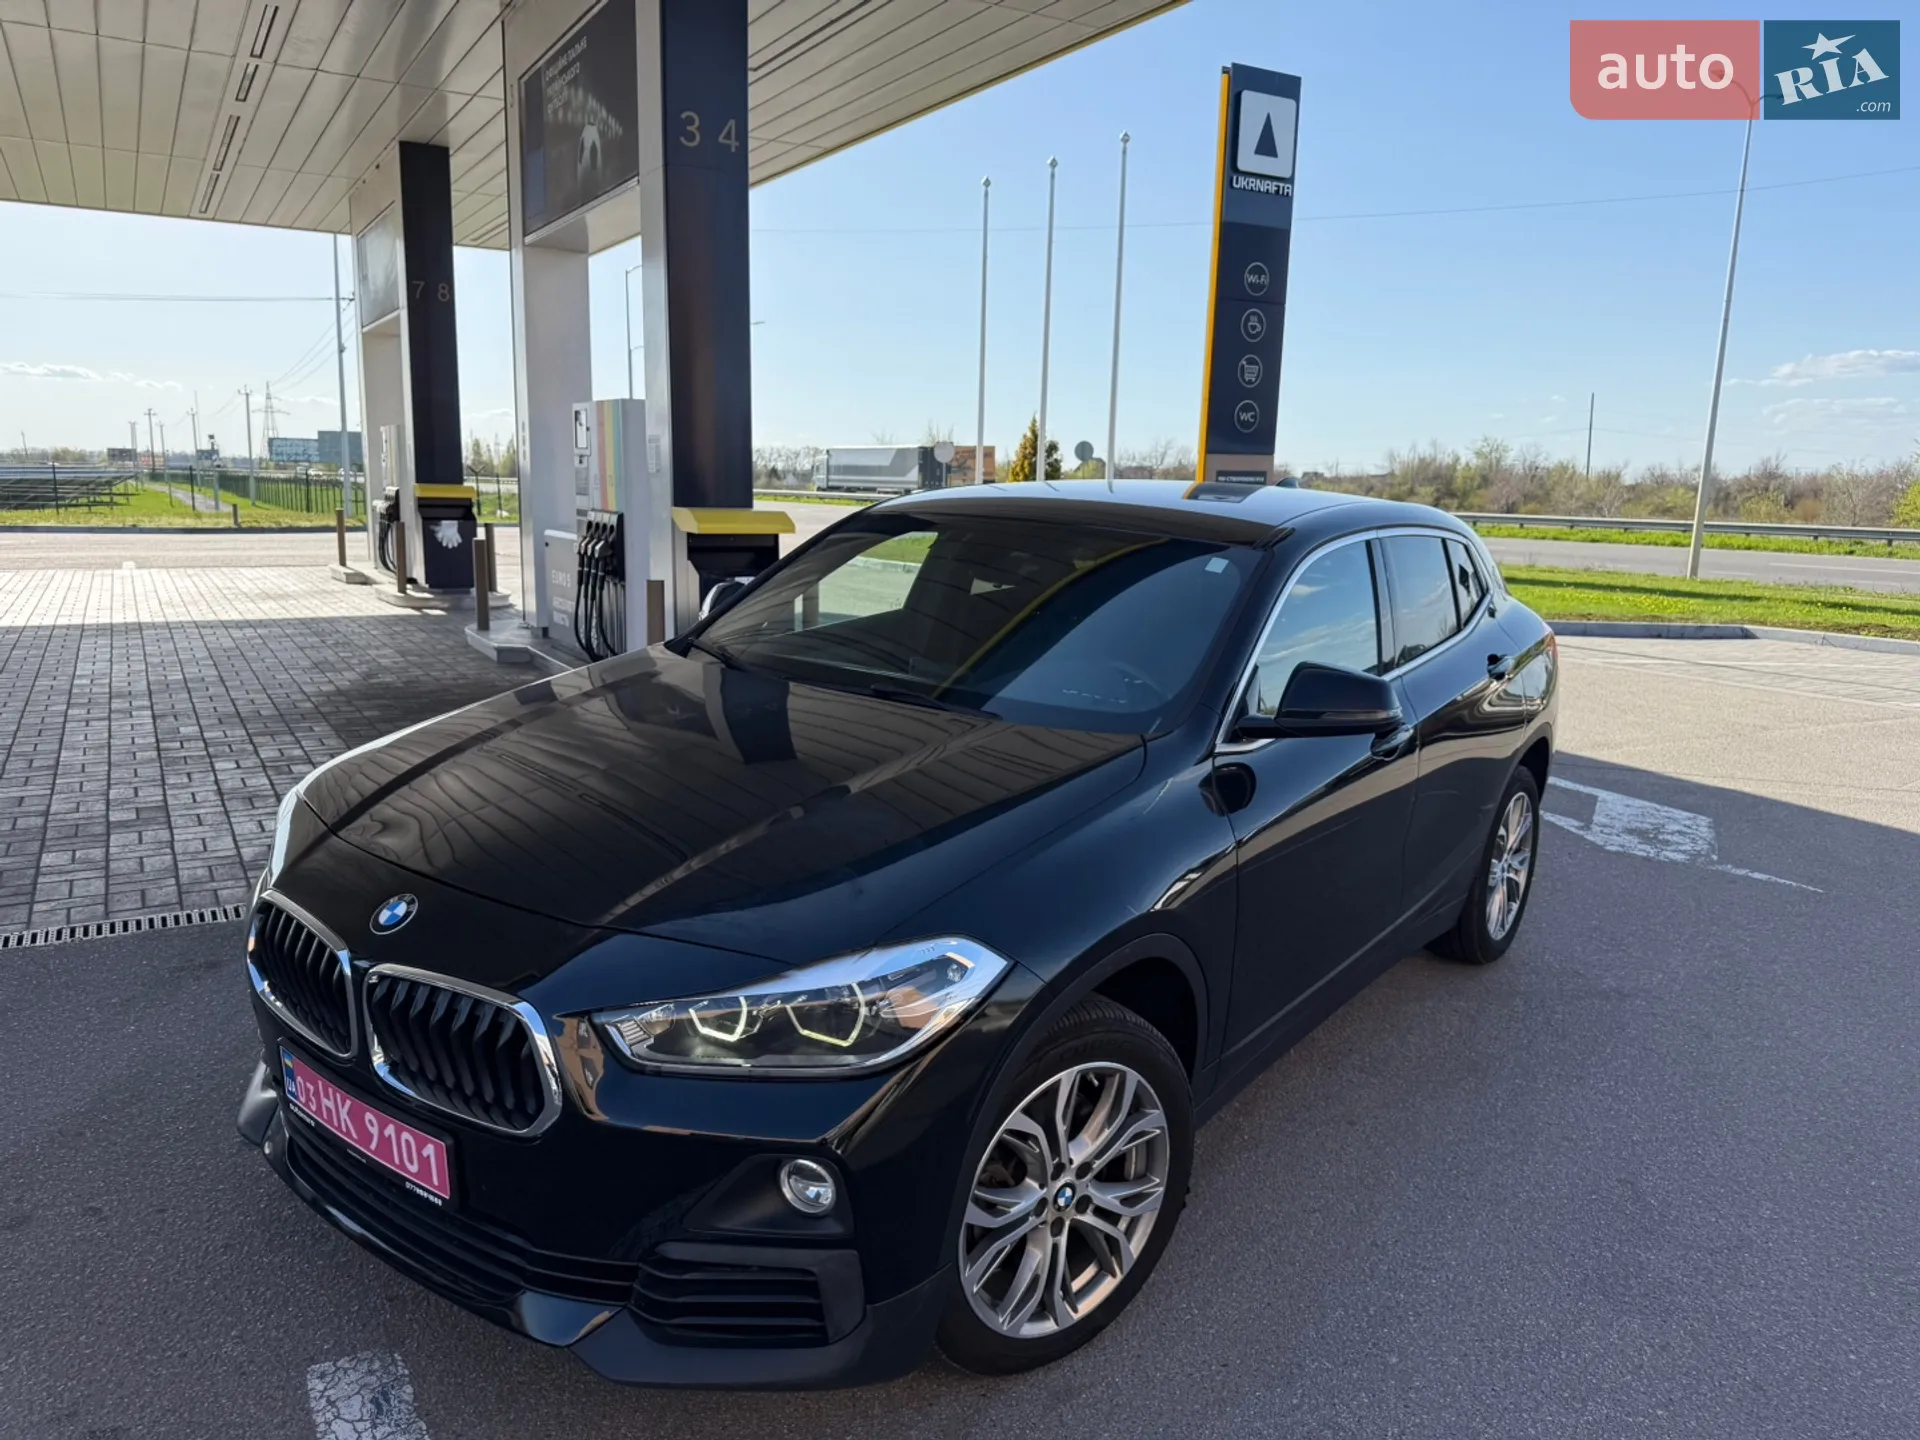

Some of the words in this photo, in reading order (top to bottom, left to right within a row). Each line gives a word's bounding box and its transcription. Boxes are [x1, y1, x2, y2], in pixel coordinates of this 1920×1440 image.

[679, 111, 701, 147] 3
[718, 118, 740, 153] 4
[1232, 174, 1292, 197] UKRNAFTA
[412, 280, 425, 300] 7
[438, 282, 450, 302] 8
[1239, 411, 1255, 423] WC
[364, 1112, 439, 1187] 9101
